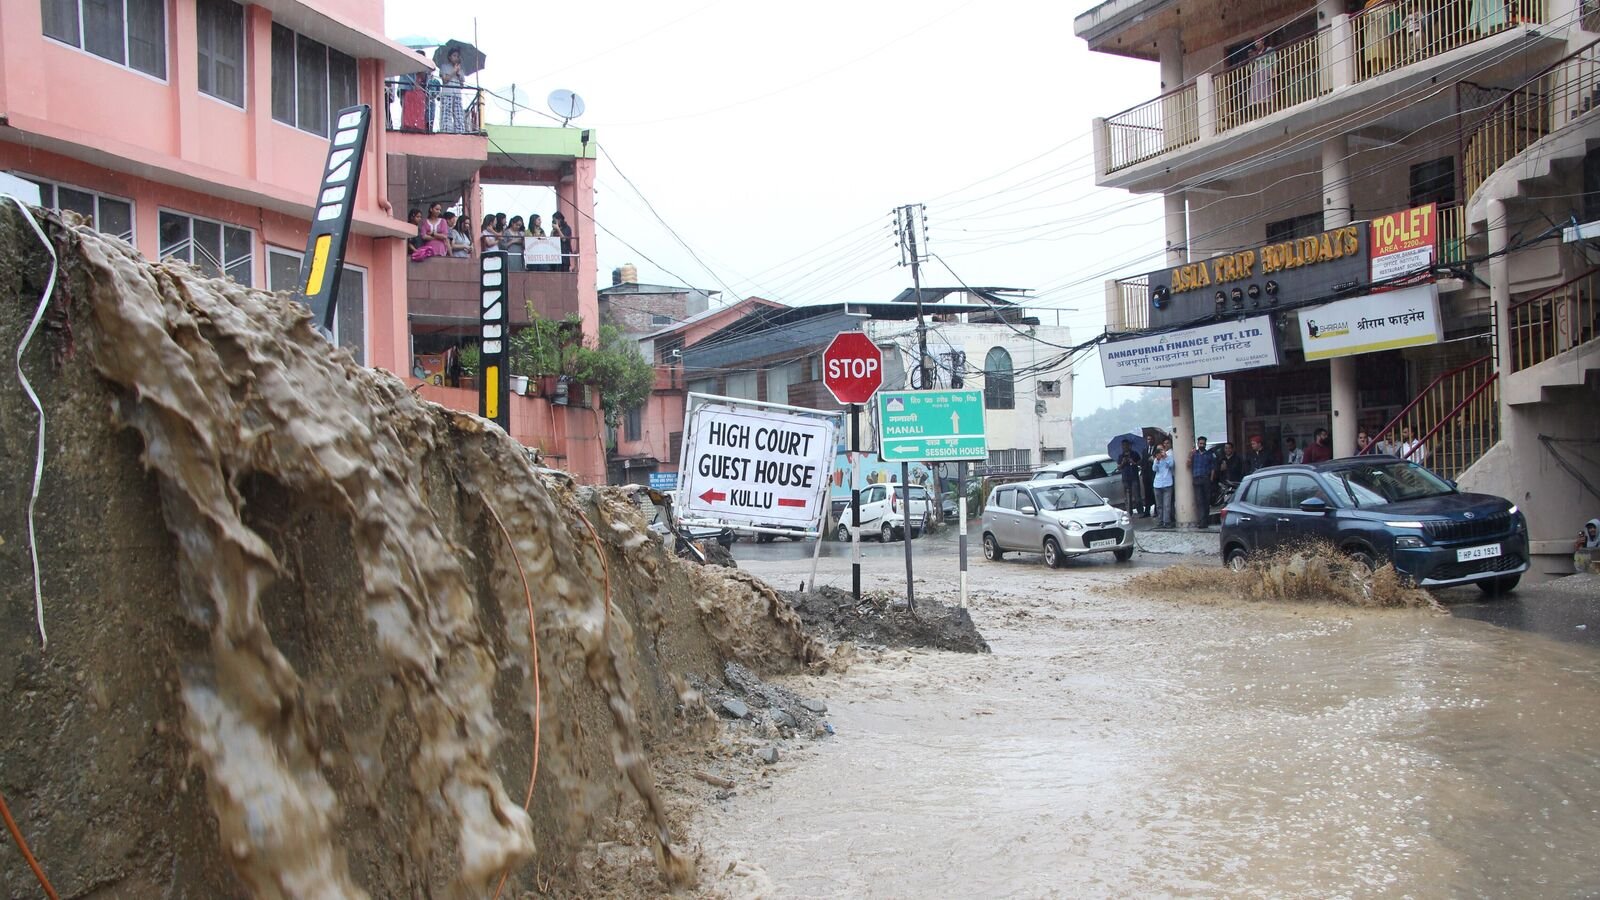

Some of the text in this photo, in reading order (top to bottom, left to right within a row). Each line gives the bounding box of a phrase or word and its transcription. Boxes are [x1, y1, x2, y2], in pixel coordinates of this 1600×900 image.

[1373, 205, 1432, 248] TO-LET
[1379, 245, 1399, 255] AREA
[1403, 240, 1419, 249] 2200
[1170, 226, 1359, 295] ASIA TRIP HOLIDAYS
[1320, 321, 1349, 333] SHRIRAM
[1357, 308, 1425, 331] श्रीराम फाइनेंस
[1108, 344, 1165, 360] ANNAPURNA
[1166, 336, 1210, 353] FINANCE
[1213, 331, 1238, 343] PVT.
[1239, 328, 1263, 339] LTD.
[828, 358, 878, 380] STOP
[708, 421, 815, 457] HIGH COURT
[886, 425, 924, 434] MANALI
[925, 446, 985, 457] SESSION HOUSE
[698, 453, 816, 489] GUEST HOUSE
[730, 488, 774, 510] KULLU
[1463, 546, 1499, 559] HP 43 1921
